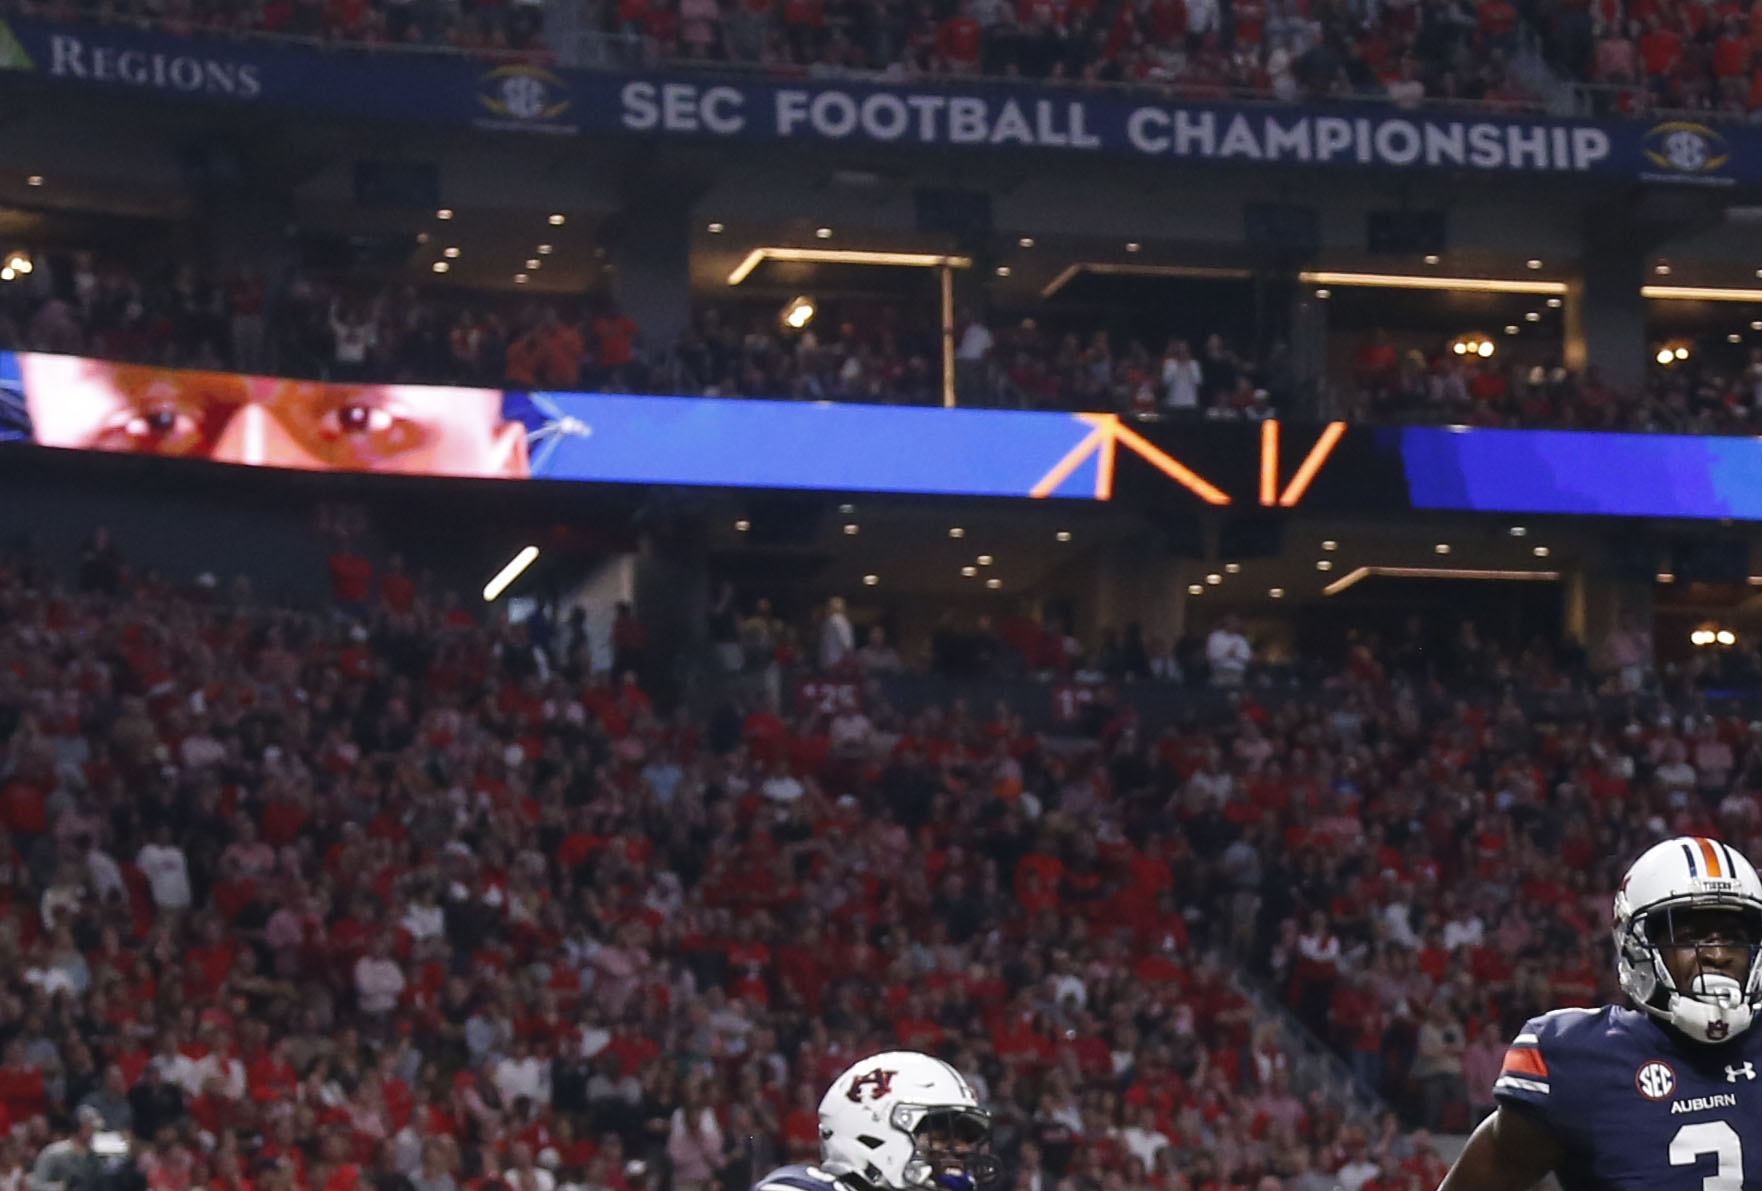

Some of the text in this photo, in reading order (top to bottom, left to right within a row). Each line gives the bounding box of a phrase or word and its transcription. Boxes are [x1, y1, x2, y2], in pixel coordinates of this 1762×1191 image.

[51, 35, 262, 97] REGIONS
[622, 81, 1611, 171] SEC FOOTBALL CHAMPIONSHIP
[1639, 1063, 1673, 1098] SEC
[1671, 1094, 1737, 1115] AUBURN
